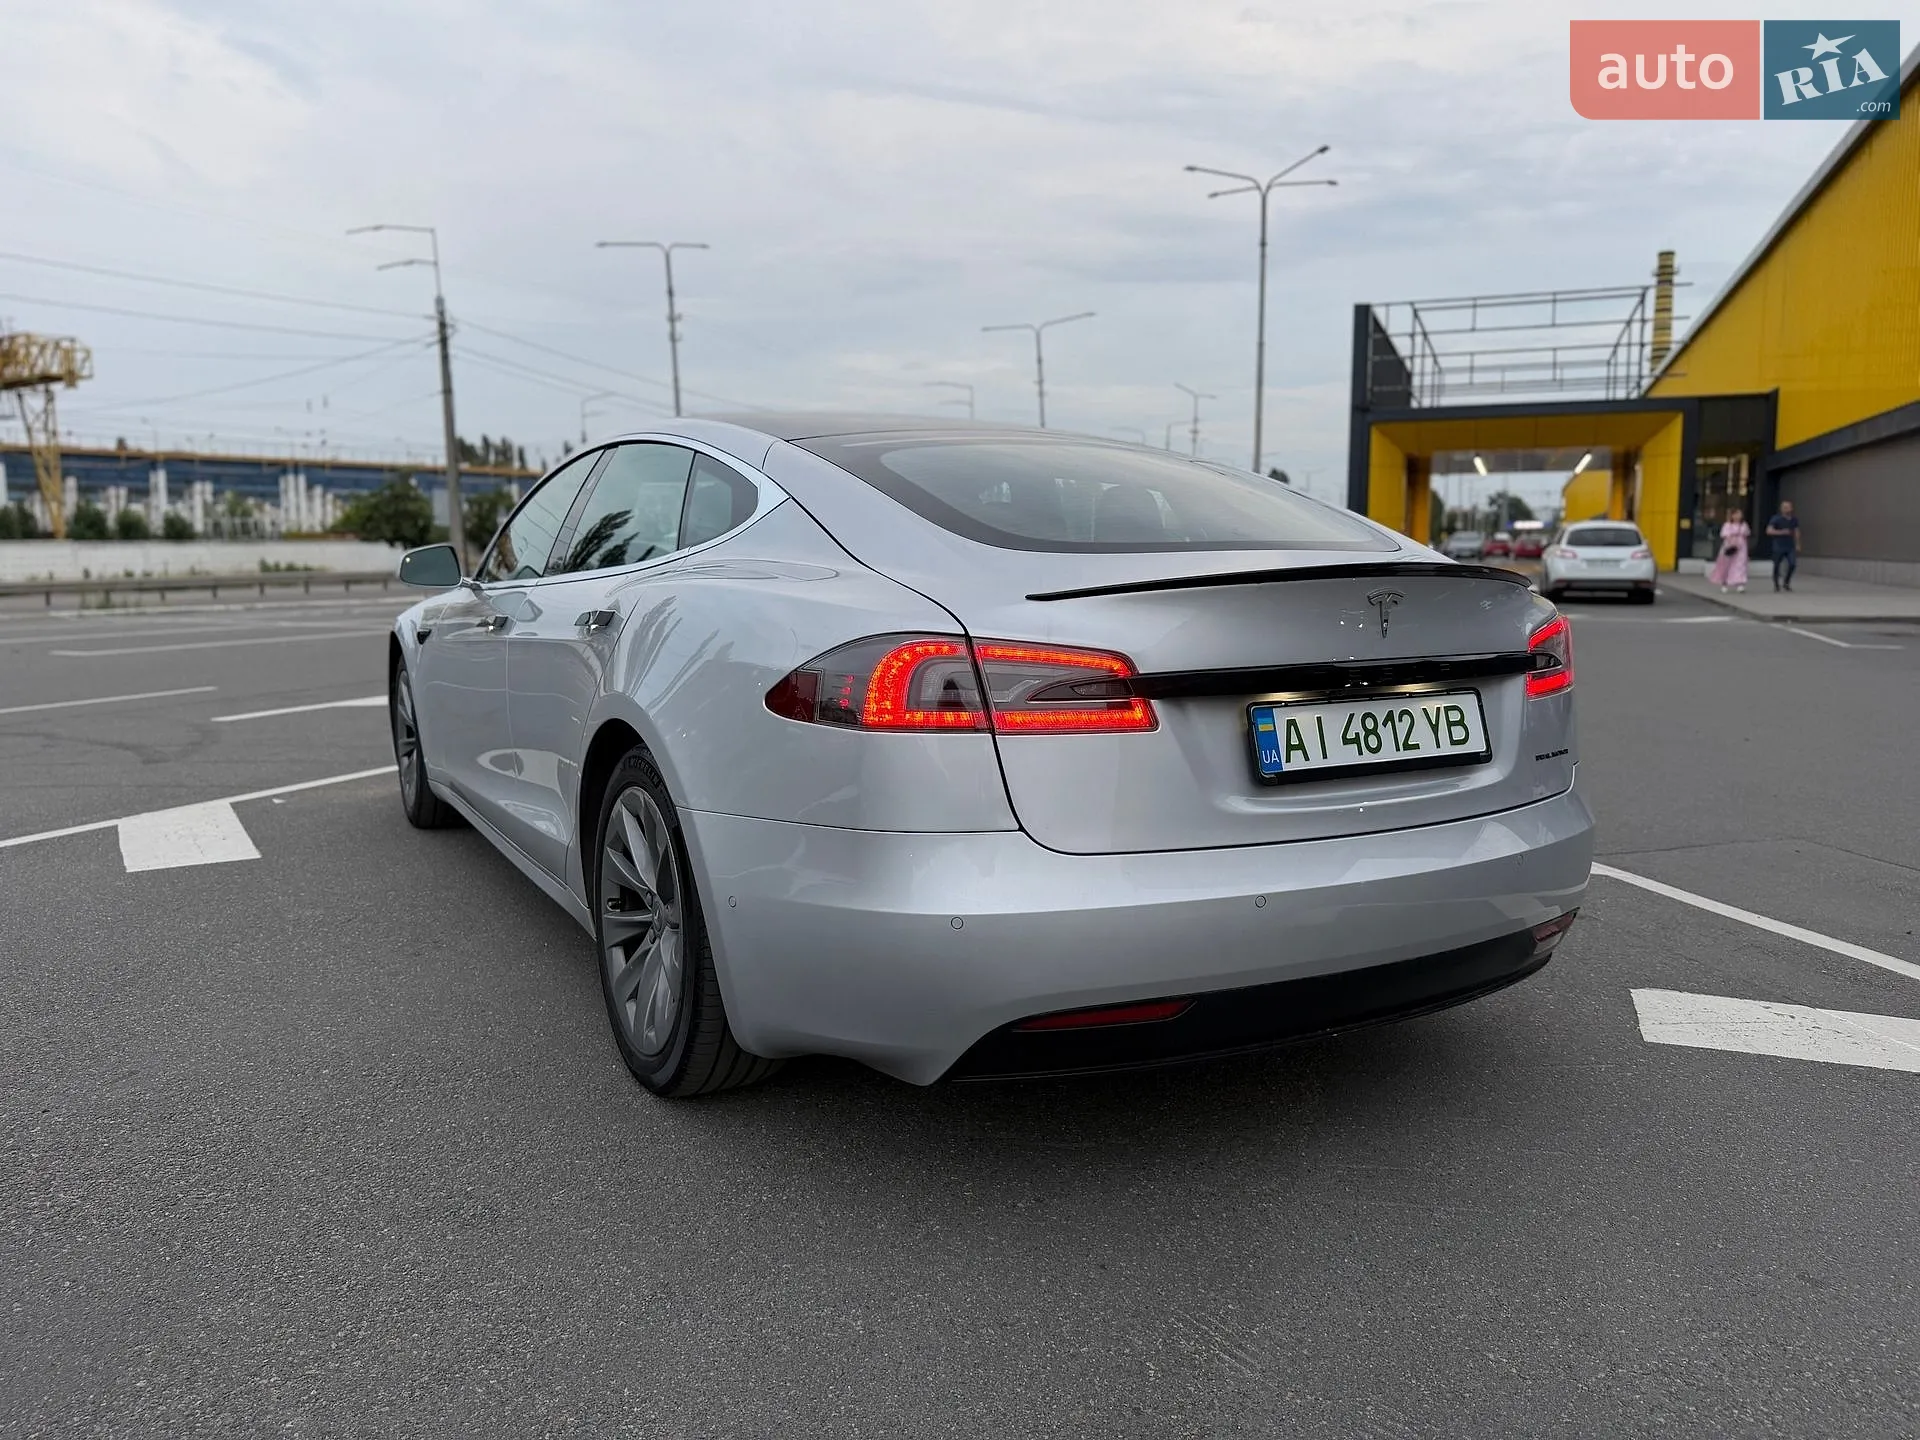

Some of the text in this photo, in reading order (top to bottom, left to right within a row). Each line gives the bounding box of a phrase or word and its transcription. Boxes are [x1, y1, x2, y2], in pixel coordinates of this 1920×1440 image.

[1284, 704, 1470, 764] AI 4812 YB
[1262, 750, 1280, 764] UA
